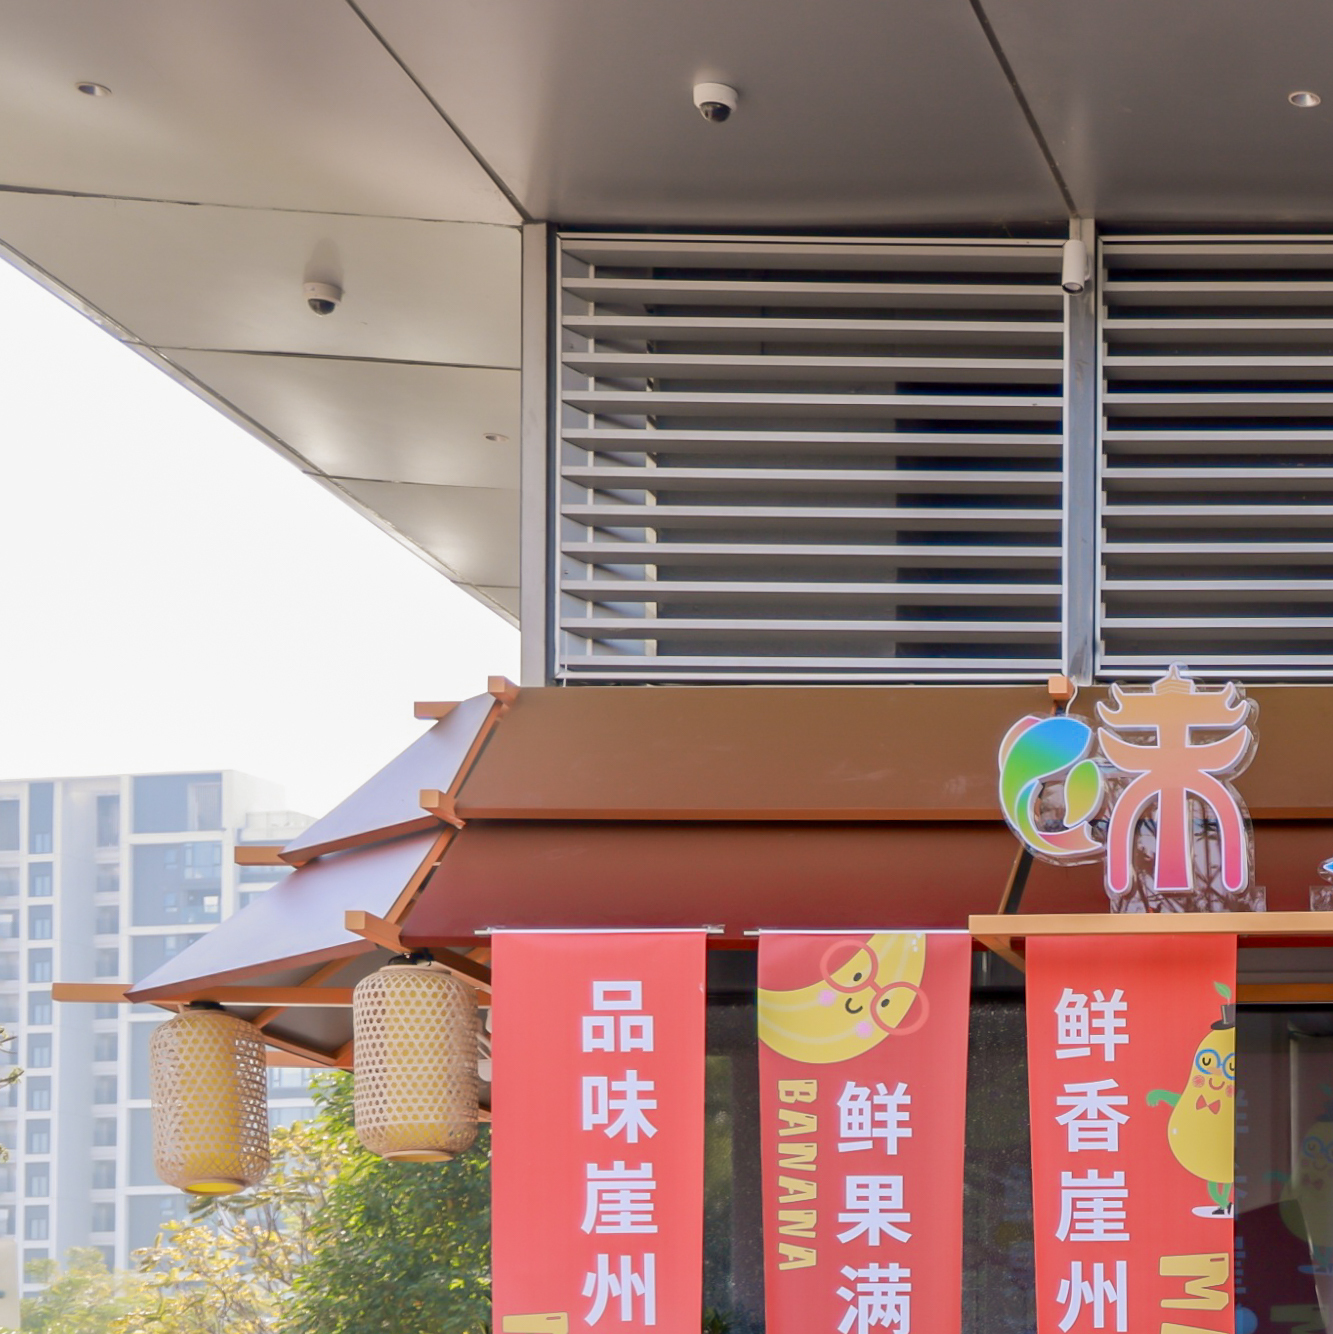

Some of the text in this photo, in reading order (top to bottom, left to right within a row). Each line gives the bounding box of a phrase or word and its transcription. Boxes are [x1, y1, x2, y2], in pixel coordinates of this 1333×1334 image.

[580, 980, 659, 1328] 品味崖州
[777, 1078, 818, 1272] BANANA
[1054, 988, 1131, 1334] 鲜香崖州
